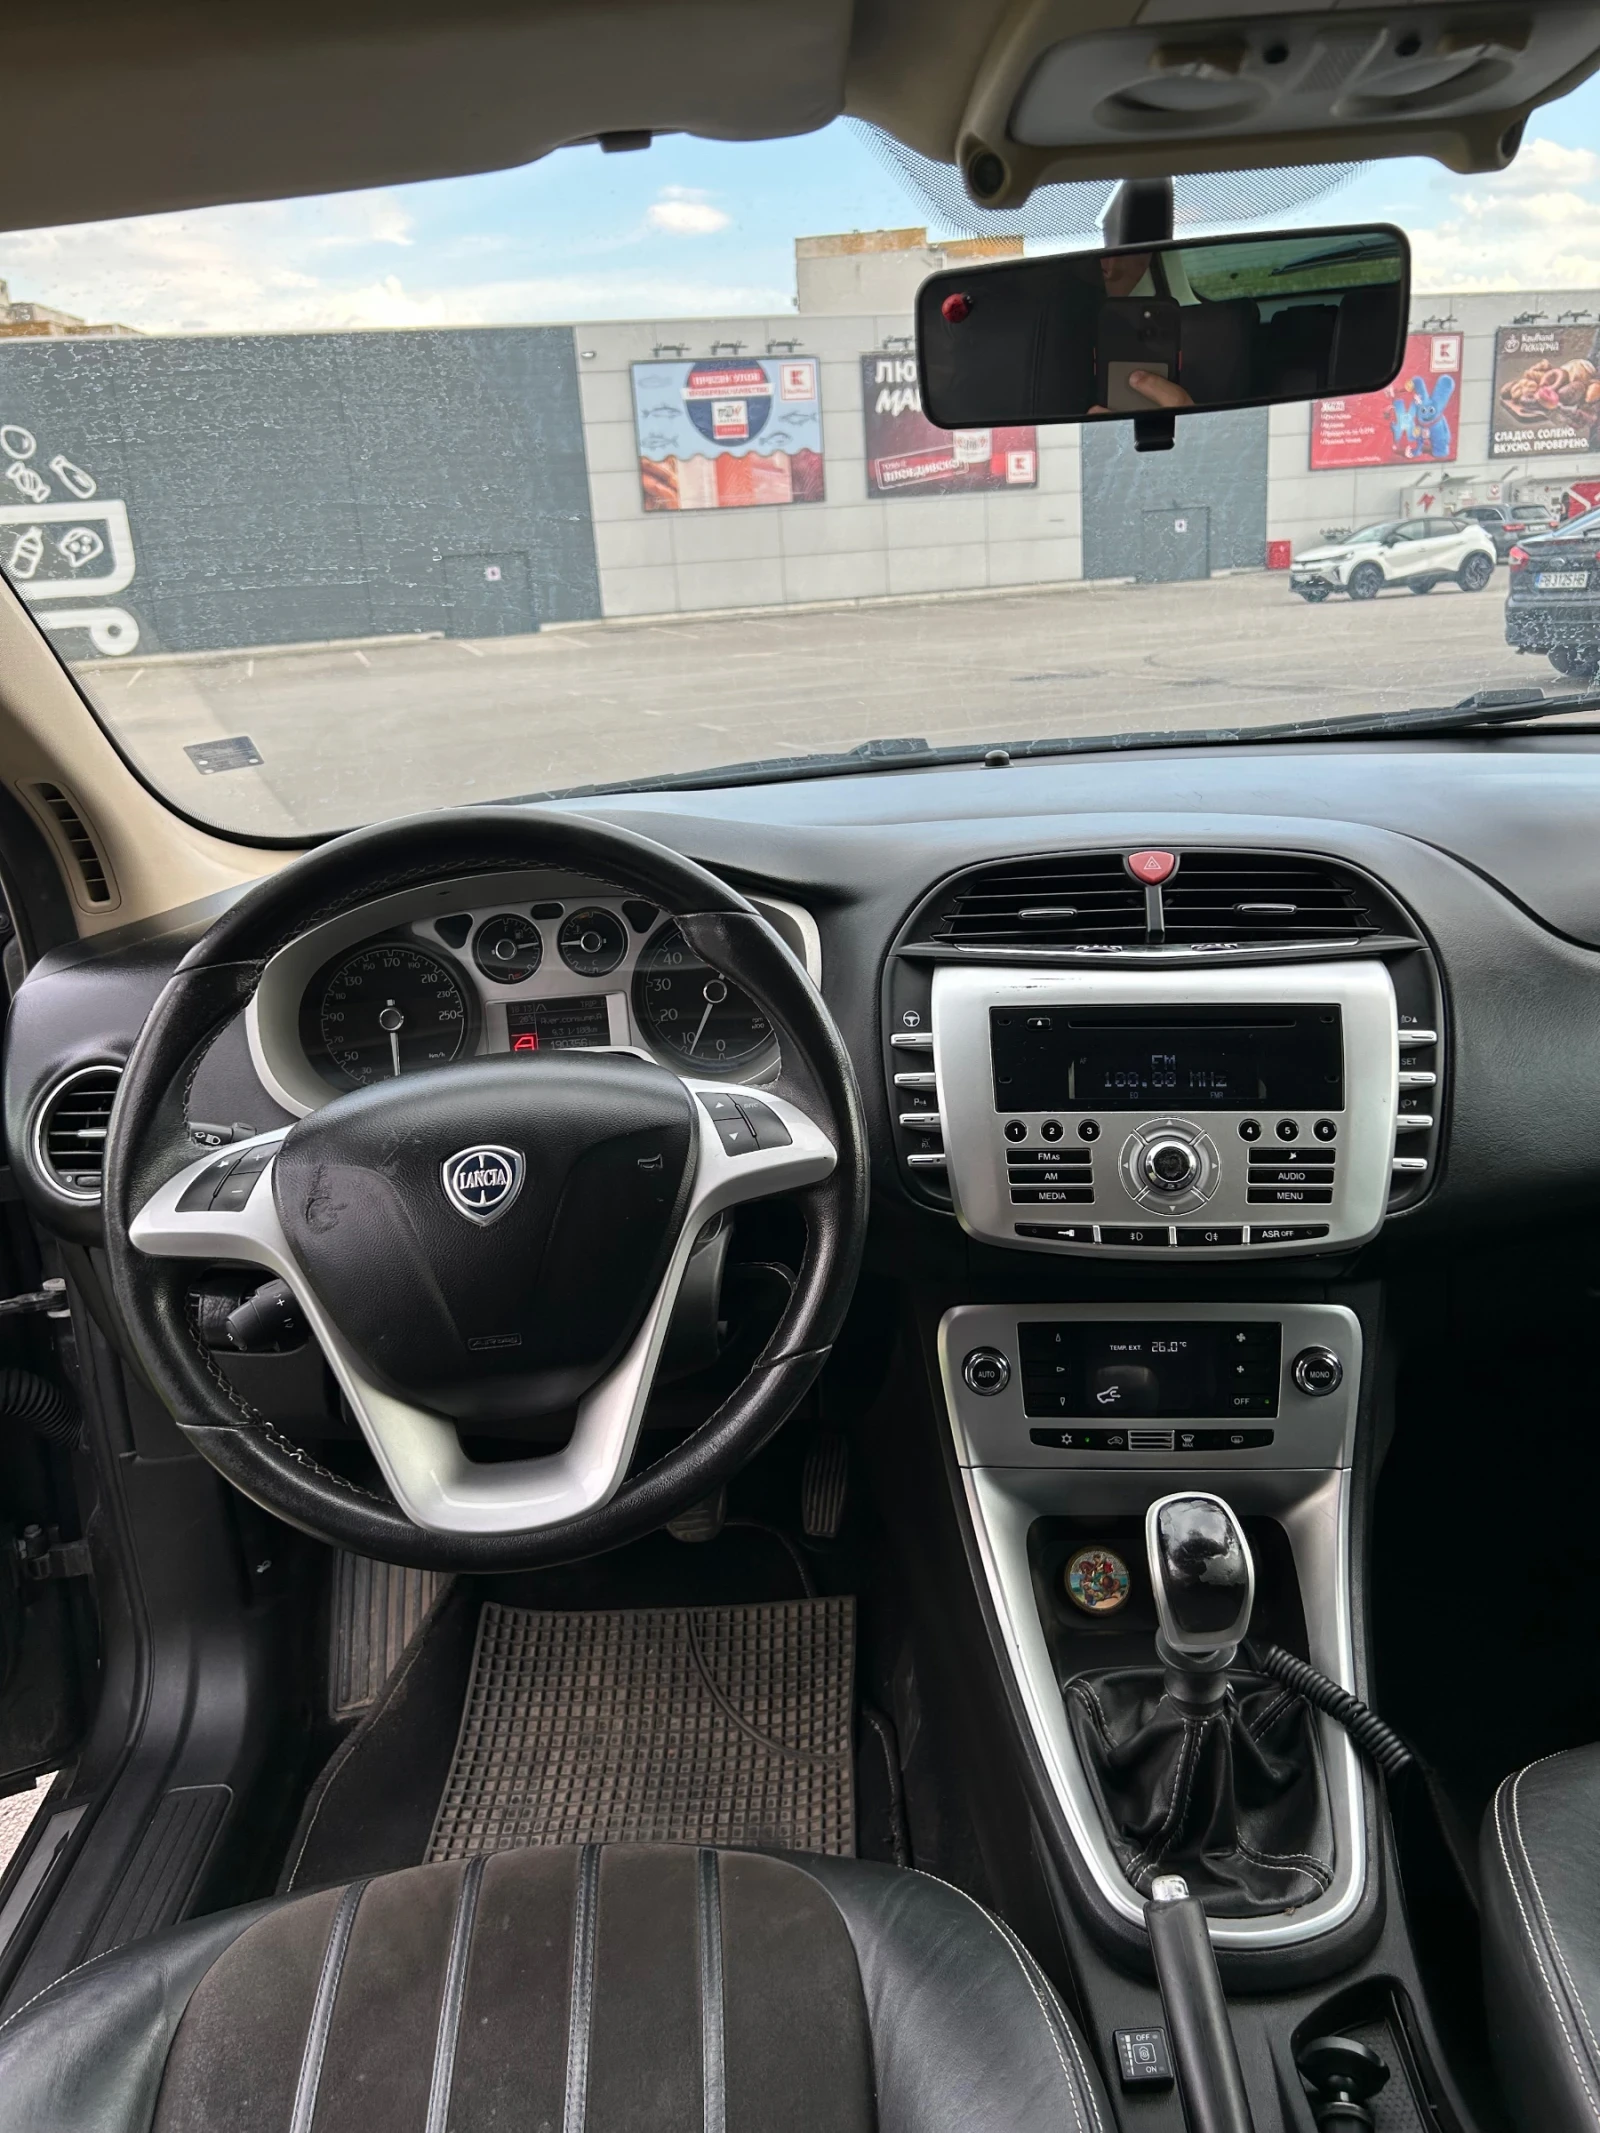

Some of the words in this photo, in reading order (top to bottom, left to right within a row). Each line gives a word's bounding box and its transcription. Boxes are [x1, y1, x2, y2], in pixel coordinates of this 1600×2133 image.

[874, 359, 918, 384] ЛЮ
[1494, 429, 1536, 442] СЛАДКО.
[1537, 427, 1577, 440] СОЛЕНО.
[1493, 441, 1533, 454] ВКУСНО.
[1534, 438, 1590, 451] ПРОВЕРЕНО.
[383, 957, 400, 968] 170
[663, 951, 682, 965] 40
[362, 962, 375, 971] 150
[407, 962, 421, 970] 190
[344, 975, 362, 986] 130
[420, 973, 438, 984] 210
[653, 978, 671, 992] 30
[335, 992, 346, 1000] 110
[436, 990, 450, 999] 230
[329, 1012, 345, 1022] 90
[438, 1010, 457, 1020] 250
[660, 1008, 678, 1022] 20
[334, 1035, 344, 1043] 70
[682, 1031, 696, 1044] 10
[716, 1039, 726, 1052] 0
[344, 1051, 359, 1061] 50
[1151, 1054, 1176, 1070] FM
[1401, 1057, 1417, 1066] SET
[361, 1066, 372, 1075] 30
[1104, 1071, 1177, 1089] 100.00
[1189, 1071, 1228, 1088] MHz
[1049, 1127, 1055, 1135] 2
[1086, 1127, 1093, 1135] 3
[1246, 1126, 1253, 1134] 4
[1284, 1126, 1291, 1135] 5
[1322, 1126, 1329, 1134] 6
[459, 1168, 507, 1190] LANCIA
[1044, 1172, 1058, 1181] AM
[1278, 1172, 1306, 1180] AUDIO
[1038, 1192, 1067, 1200] MEDIA
[1276, 1191, 1304, 1200] MENU
[1261, 1230, 1280, 1239] ASR
[977, 1370, 995, 1379] AUTO
[1309, 1370, 1330, 1379] MONO
[1233, 1397, 1250, 1406] OFF
